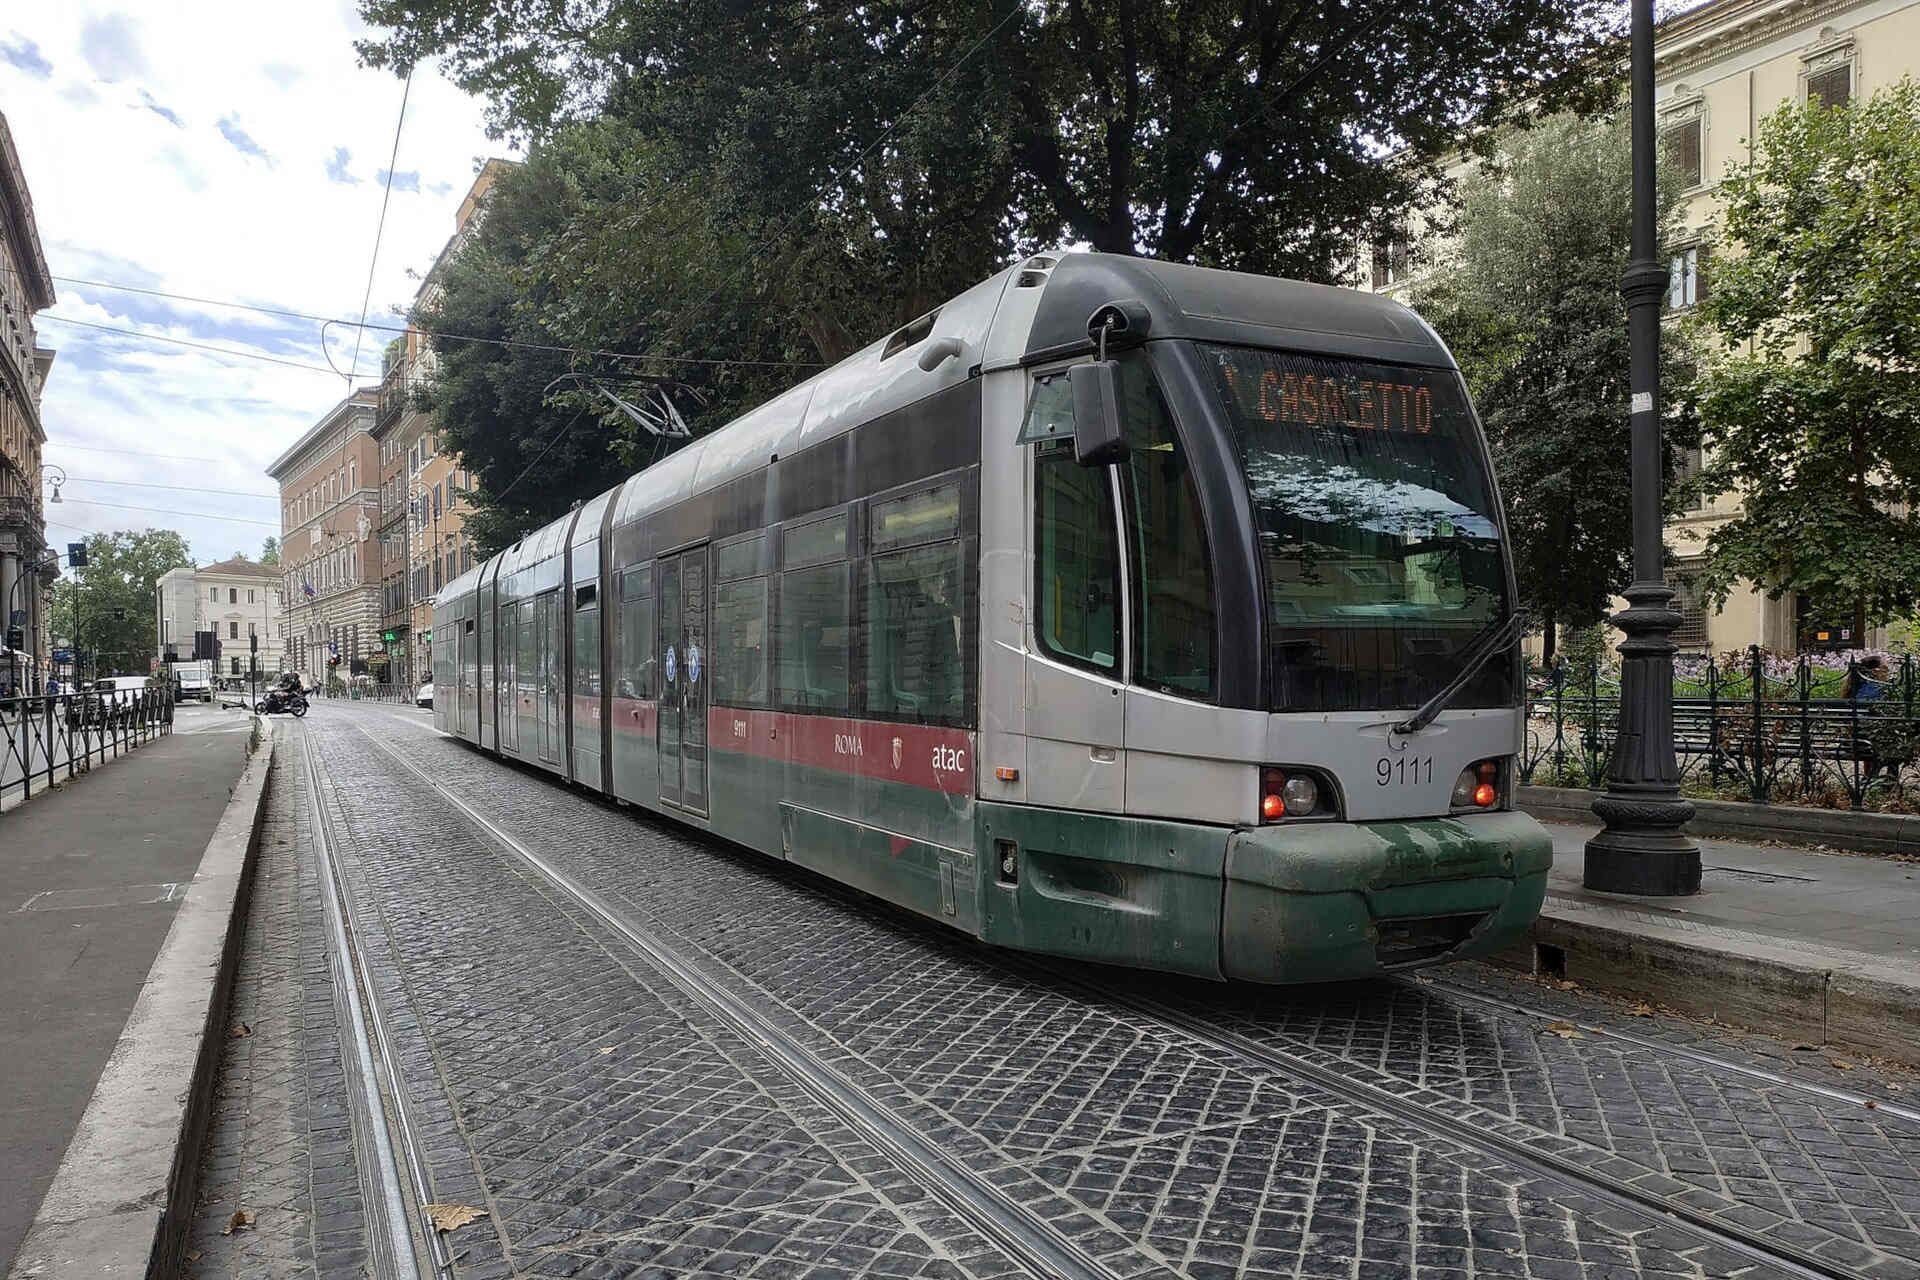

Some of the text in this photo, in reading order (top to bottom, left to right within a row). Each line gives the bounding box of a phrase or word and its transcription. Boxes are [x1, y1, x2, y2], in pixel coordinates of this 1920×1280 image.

[1257, 367, 1432, 434] CASALETTO
[733, 719, 746, 738] 9111
[834, 734, 864, 757] ROMA
[931, 743, 965, 772] atac
[1376, 756, 1432, 786] 9111
